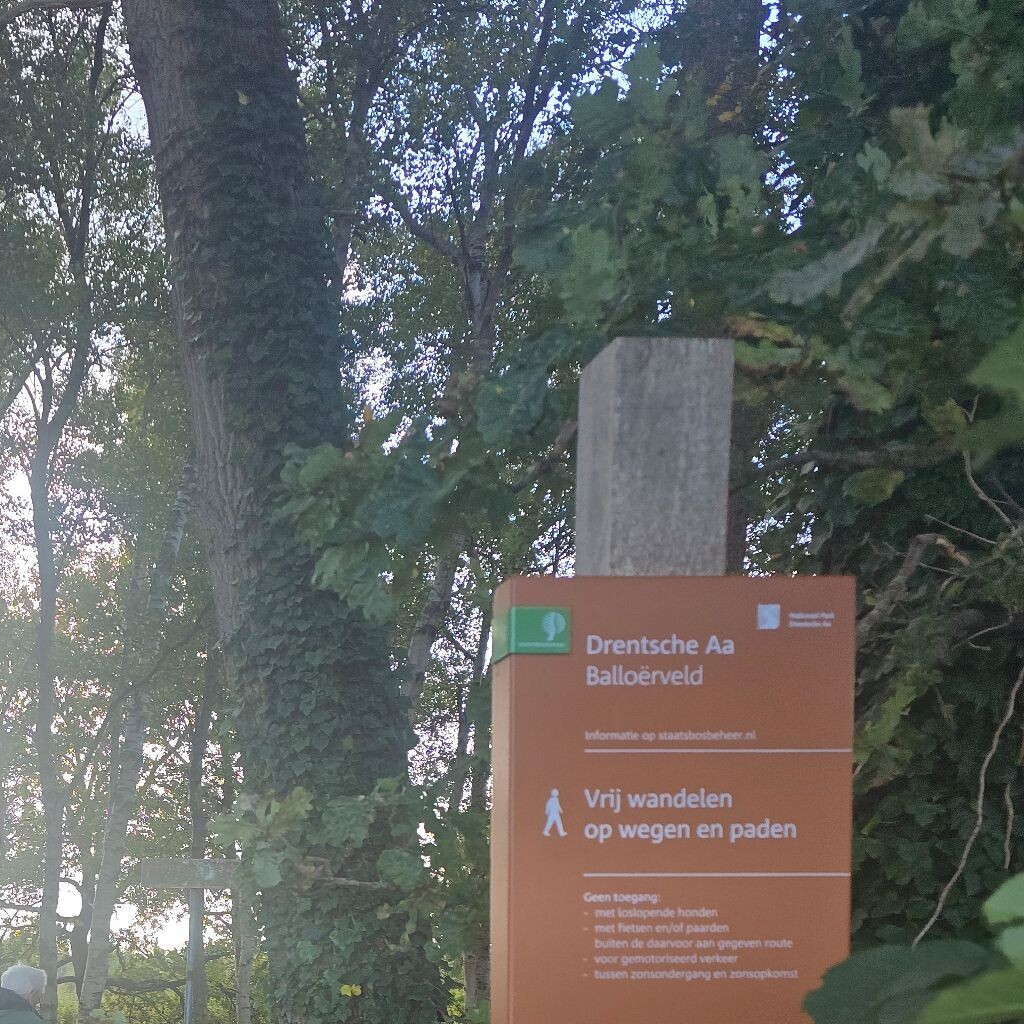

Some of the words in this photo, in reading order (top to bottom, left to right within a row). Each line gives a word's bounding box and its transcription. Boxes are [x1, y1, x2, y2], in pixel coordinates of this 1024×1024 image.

[586, 634, 698, 655] Drentsche
[705, 635, 735, 655] Aa
[586, 665, 704, 686] Balloërveld
[585, 730, 639, 741] Informatie
[642, 732, 656, 744] op
[658, 730, 756, 741] staatsbosbeheer.nl
[584, 788, 621, 813] Vrij
[627, 788, 733, 808] wandelen
[584, 821, 613, 843] op
[619, 821, 690, 843] wegen
[697, 821, 724, 838] en
[730, 818, 797, 843] paden
[583, 892, 611, 902] Geen
[613, 893, 662, 904] toegang:
[594, 908, 615, 917] met
[617, 907, 675, 919] loslopende
[677, 907, 718, 917] honden
[594, 924, 615, 933] met
[618, 922, 653, 933] fietsen
[655, 922, 684, 933] en/of
[686, 922, 729, 934] paarden
[594, 939, 628, 948] buiten
[630, 939, 644, 948] de
[646, 939, 693, 948] daarvoor
[696, 940, 715, 948] aan
[718, 940, 762, 950] gegeven
[764, 939, 793, 948] route
[594, 955, 618, 963] voor
[699, 954, 738, 963] verkeer
[594, 970, 628, 979] tussen
[630, 969, 711, 981] zonsondergang
[713, 970, 727, 979] en
